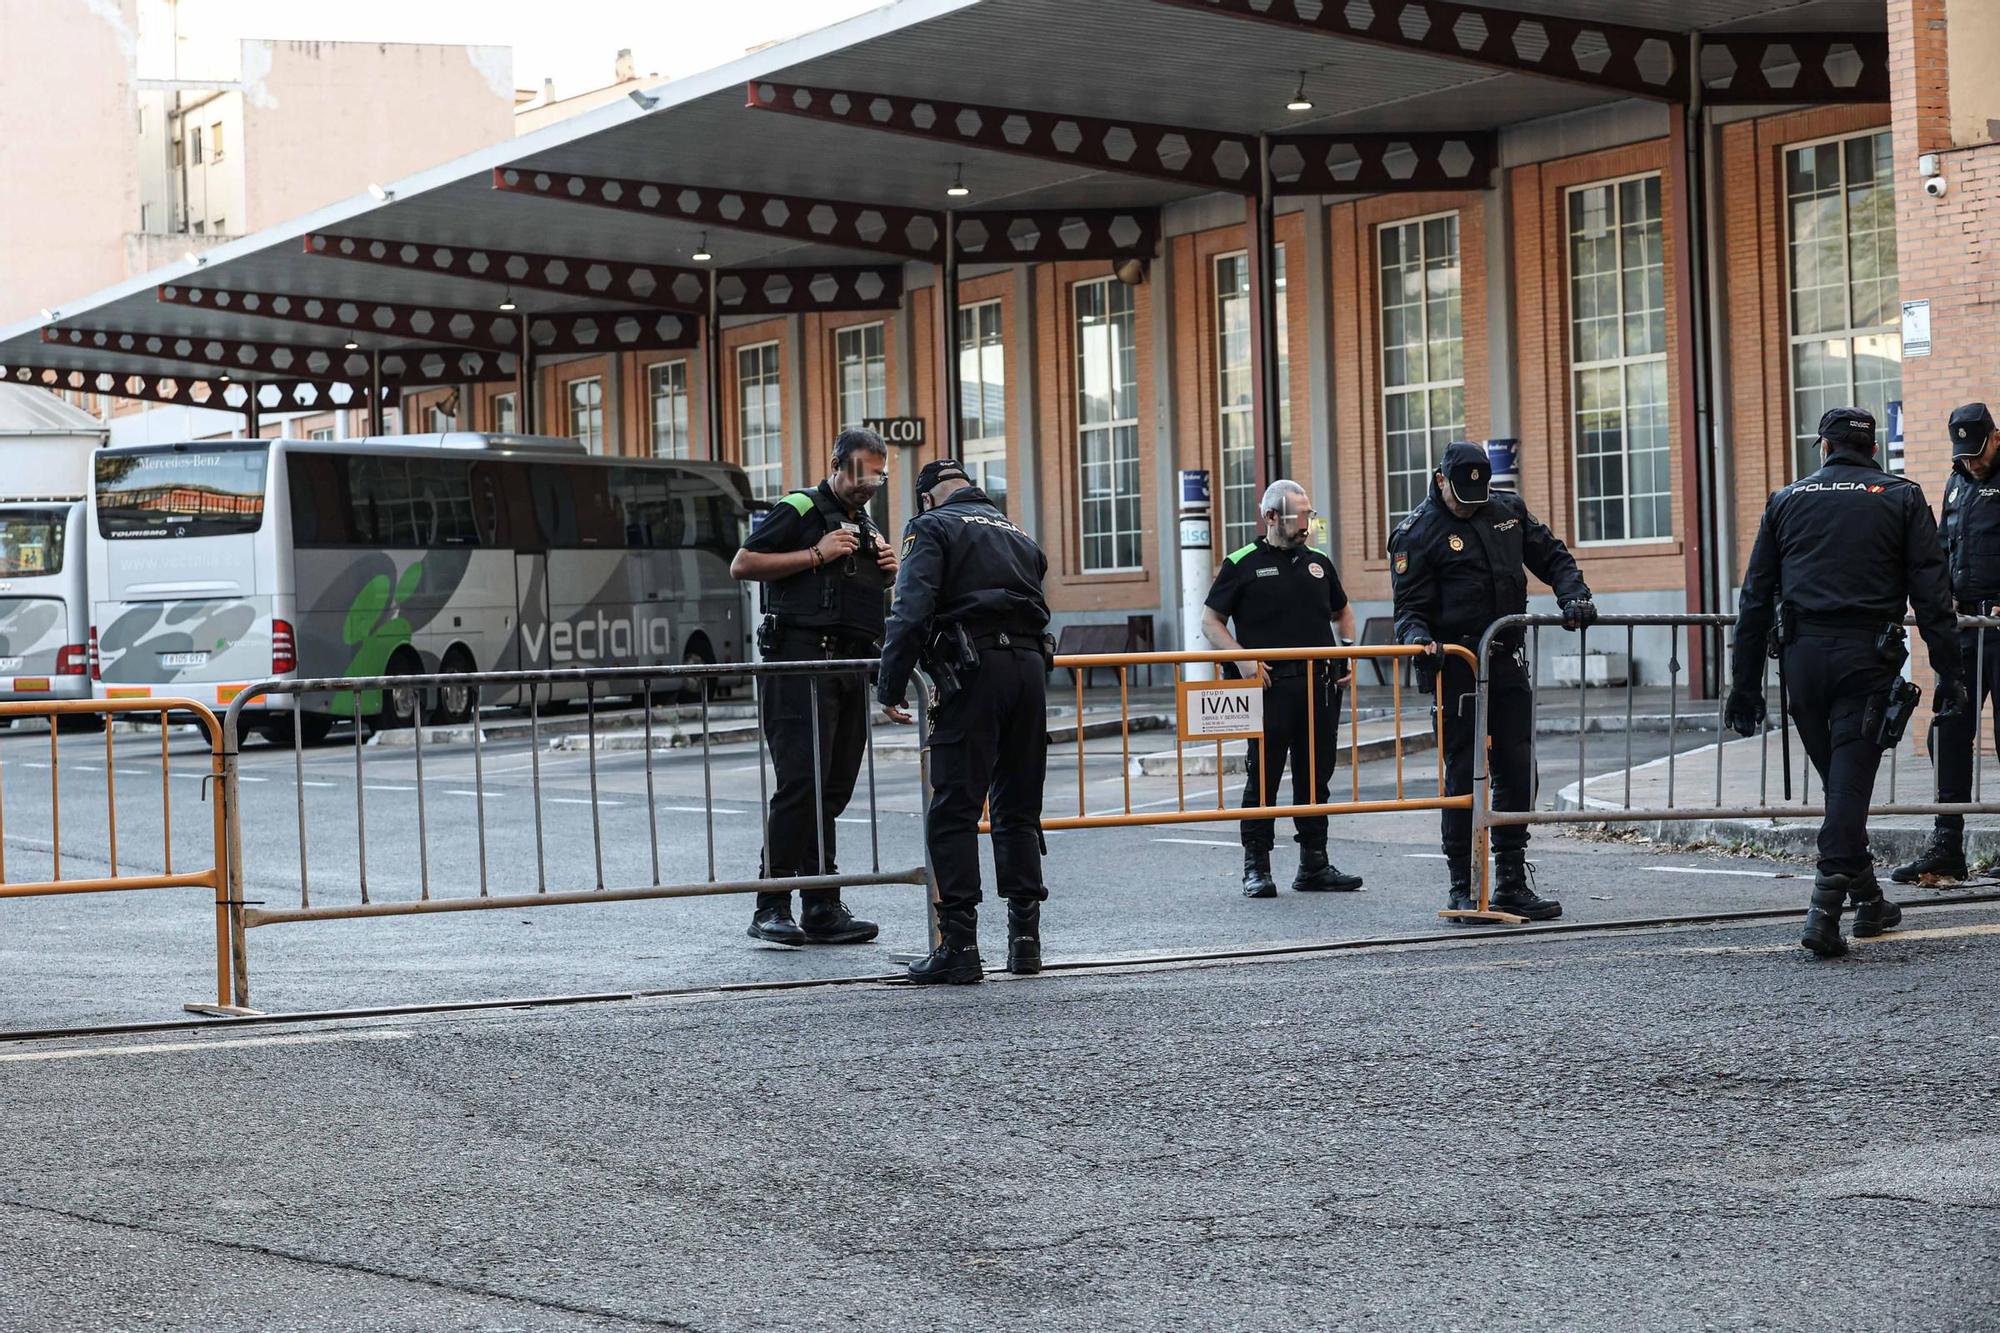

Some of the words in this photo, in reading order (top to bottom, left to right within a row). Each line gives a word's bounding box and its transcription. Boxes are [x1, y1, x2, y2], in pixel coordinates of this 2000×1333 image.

[868, 421, 921, 440] ALCOI
[138, 456, 221, 470] Mercedes-Benz
[1791, 482, 1868, 494] POLICIA
[110, 529, 168, 538] TOURISMO
[521, 604, 670, 663] vectalia
[1201, 696, 1249, 714] IVAN
